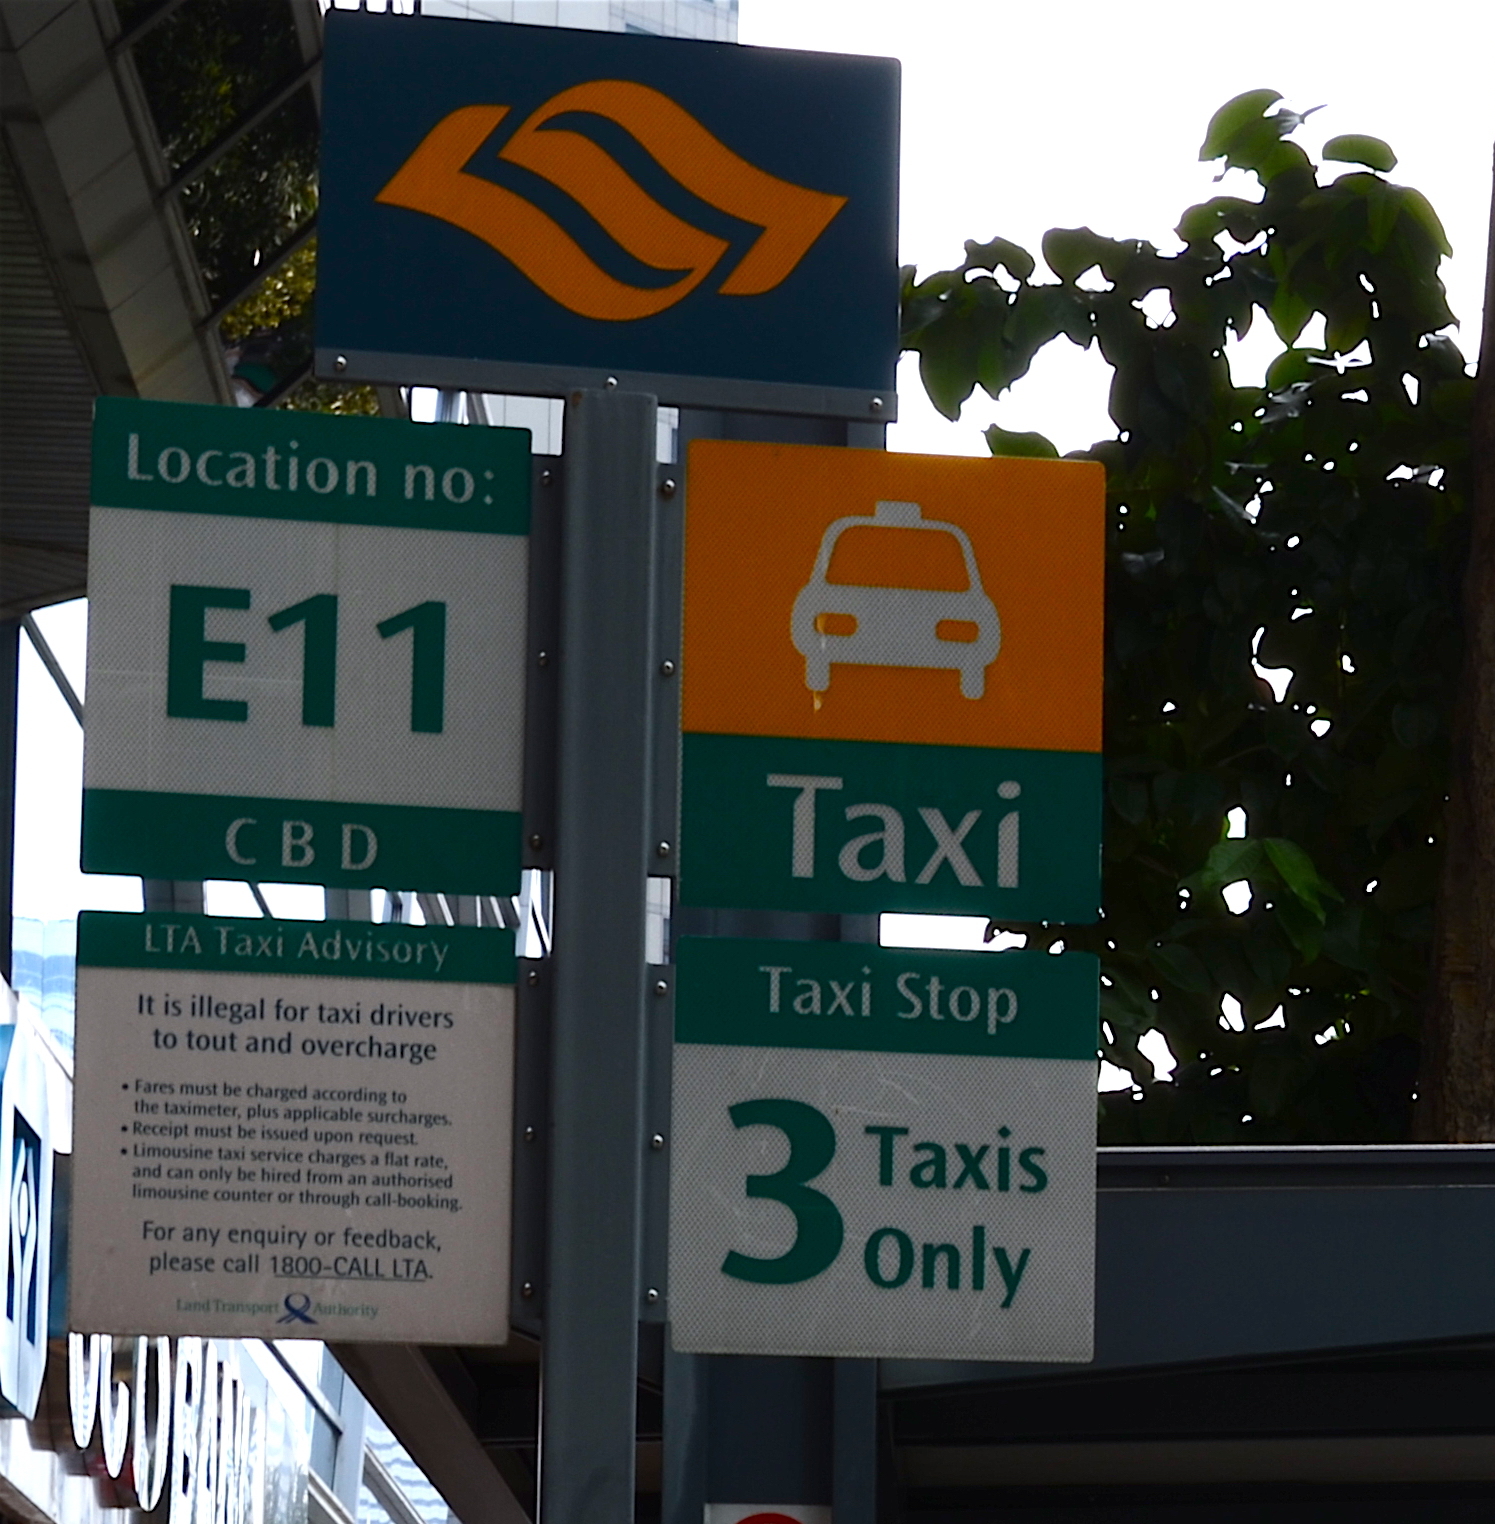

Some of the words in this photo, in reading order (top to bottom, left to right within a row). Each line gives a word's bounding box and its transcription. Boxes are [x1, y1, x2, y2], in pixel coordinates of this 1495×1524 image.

[127, 432, 377, 497] Location
[404, 463, 495, 505] no:
[166, 584, 447, 735] E11
[766, 772, 1023, 889] Taxi
[144, 923, 203, 955] LTA
[213, 924, 284, 957] Taxi
[297, 929, 450, 973] Advisory
[138, 993, 155, 1016] It
[165, 993, 181, 1017] is
[191, 994, 265, 1025] illegal
[275, 997, 309, 1022] for
[319, 1001, 361, 1025] taxi
[371, 1003, 453, 1029] drivers
[758, 965, 874, 1018] Taxi
[896, 972, 1020, 1035] Stop
[153, 1028, 177, 1050] to
[187, 1029, 237, 1052] tout
[245, 1032, 291, 1055] and
[302, 1035, 437, 1065] overcharge
[134, 1079, 175, 1095] Fares
[180, 1082, 218, 1096] must
[223, 1082, 242, 1097] be
[246, 1083, 307, 1103] charged
[312, 1086, 388, 1107] according
[392, 1090, 407, 1105] to
[134, 1099, 159, 1115] the
[164, 1101, 242, 1120] taximeter,
[247, 1103, 279, 1122] plus
[283, 1105, 363, 1124] applicable
[367, 1109, 453, 1129] surcharges.
[133, 1120, 189, 1140] Receipt
[194, 1124, 232, 1139] must
[237, 1123, 257, 1140] be
[261, 1124, 309, 1142] issued
[313, 1130, 354, 1145] upon
[358, 1131, 419, 1148] request.
[133, 1143, 213, 1161] Limousine
[218, 1145, 246, 1161] taxi
[251, 1147, 304, 1163] service
[308, 1149, 366, 1168] charges
[370, 1154, 379, 1167] a
[384, 1151, 409, 1167] flat
[414, 1154, 449, 1171] rate,
[132, 1163, 162, 1179] and
[166, 1166, 194, 1180] can
[199, 1166, 232, 1184] only
[237, 1166, 257, 1182] be
[261, 1168, 301, 1183] hired
[306, 1169, 343, 1185] from
[347, 1173, 367, 1187] an
[371, 1172, 454, 1189] authorised
[719, 1097, 846, 1286] 3
[863, 1125, 1050, 1195] Taxis
[132, 1184, 210, 1201] limousine
[213, 1188, 273, 1203] counter
[278, 1191, 294, 1204] or
[299, 1189, 360, 1209] through
[365, 1192, 463, 1213] call-booking.
[142, 1221, 176, 1242] For
[182, 1225, 221, 1248] any
[227, 1224, 308, 1250] enquiry
[314, 1230, 336, 1247] or
[343, 1226, 442, 1253] feedback,
[149, 1252, 216, 1276] please
[223, 1253, 260, 1274] call
[271, 1255, 386, 1279] 1800-CALL
[392, 1258, 434, 1280] LTA.
[863, 1225, 1033, 1309] Only
[176, 1298, 211, 1313] Land
[213, 1299, 280, 1316] Transport
[313, 1302, 379, 1319] Authority
